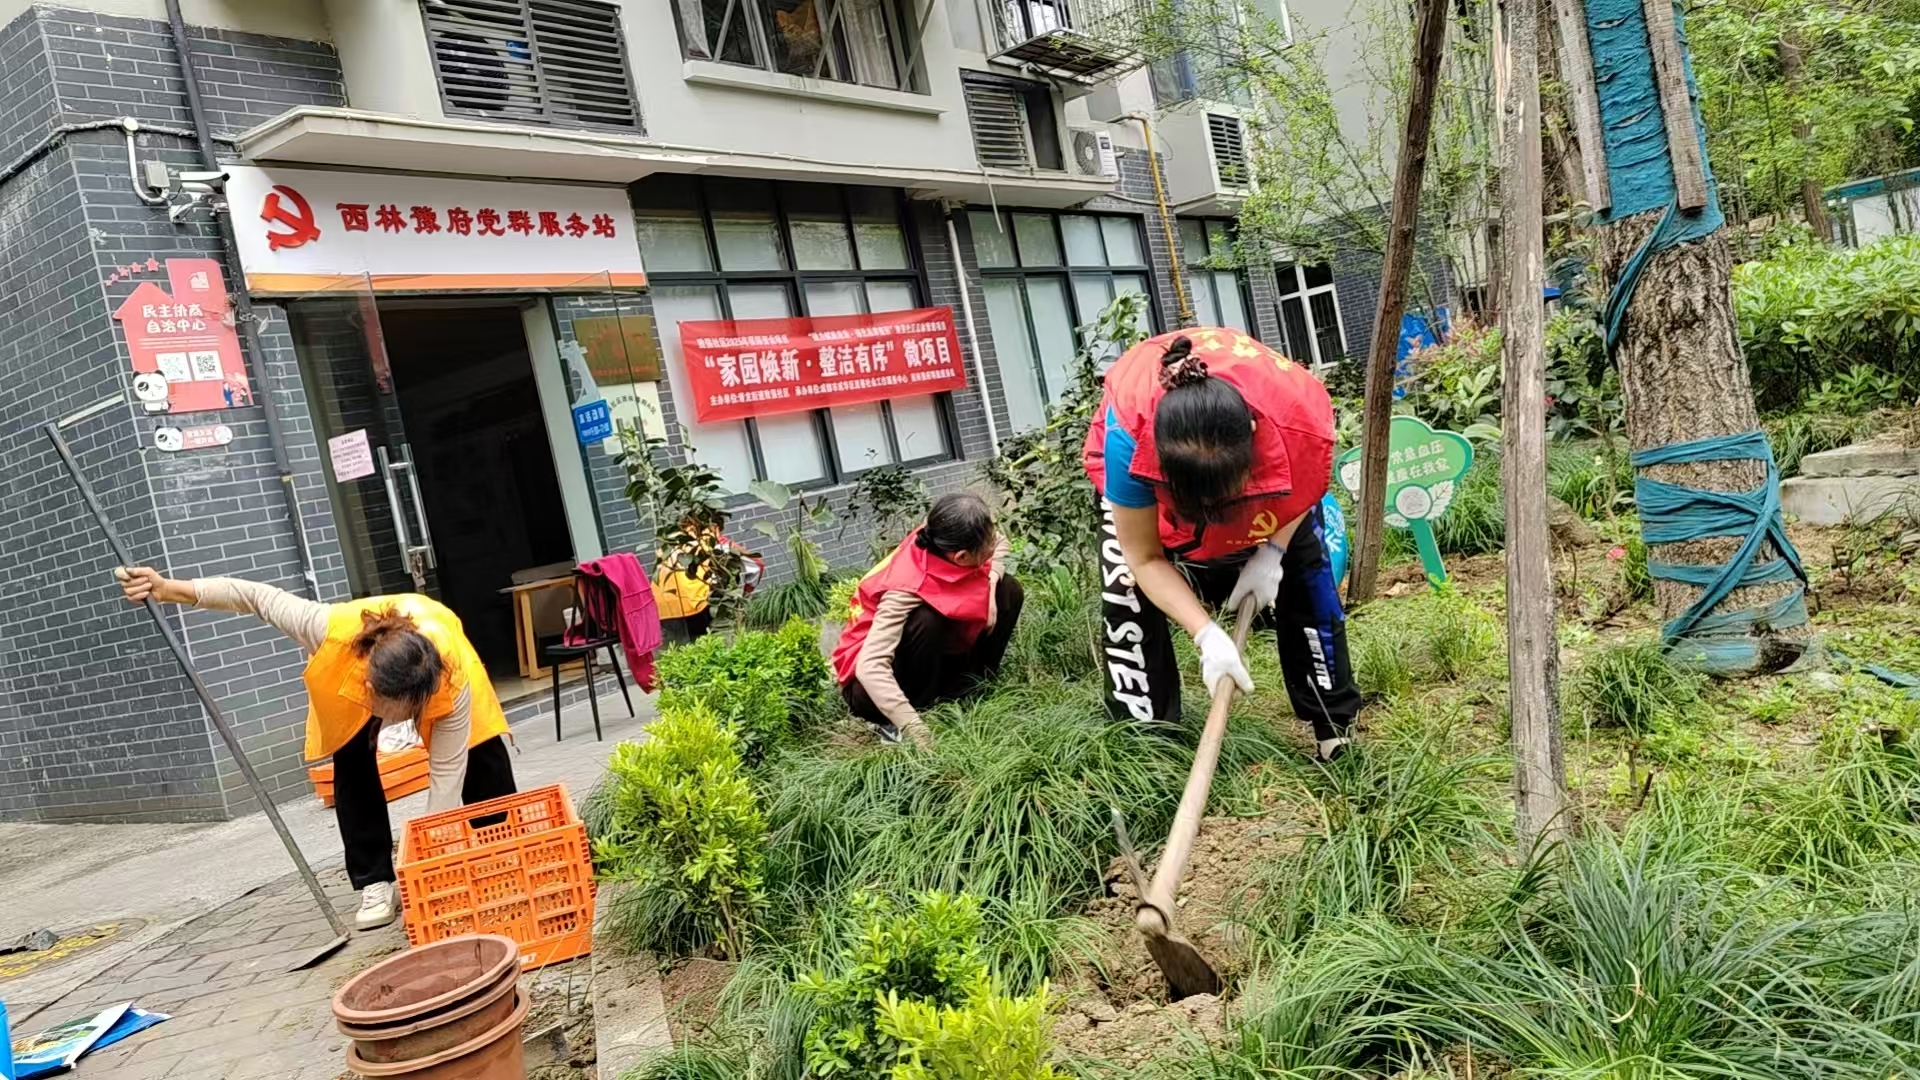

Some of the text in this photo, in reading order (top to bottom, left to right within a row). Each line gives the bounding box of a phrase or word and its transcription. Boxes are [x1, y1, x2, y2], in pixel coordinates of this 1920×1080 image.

[336, 203, 616, 239] 西林豫府党群服务站
[142, 303, 204, 318] 民主协商
[146, 318, 207, 334] 自治中心
[1104, 623, 1154, 722] STEP
